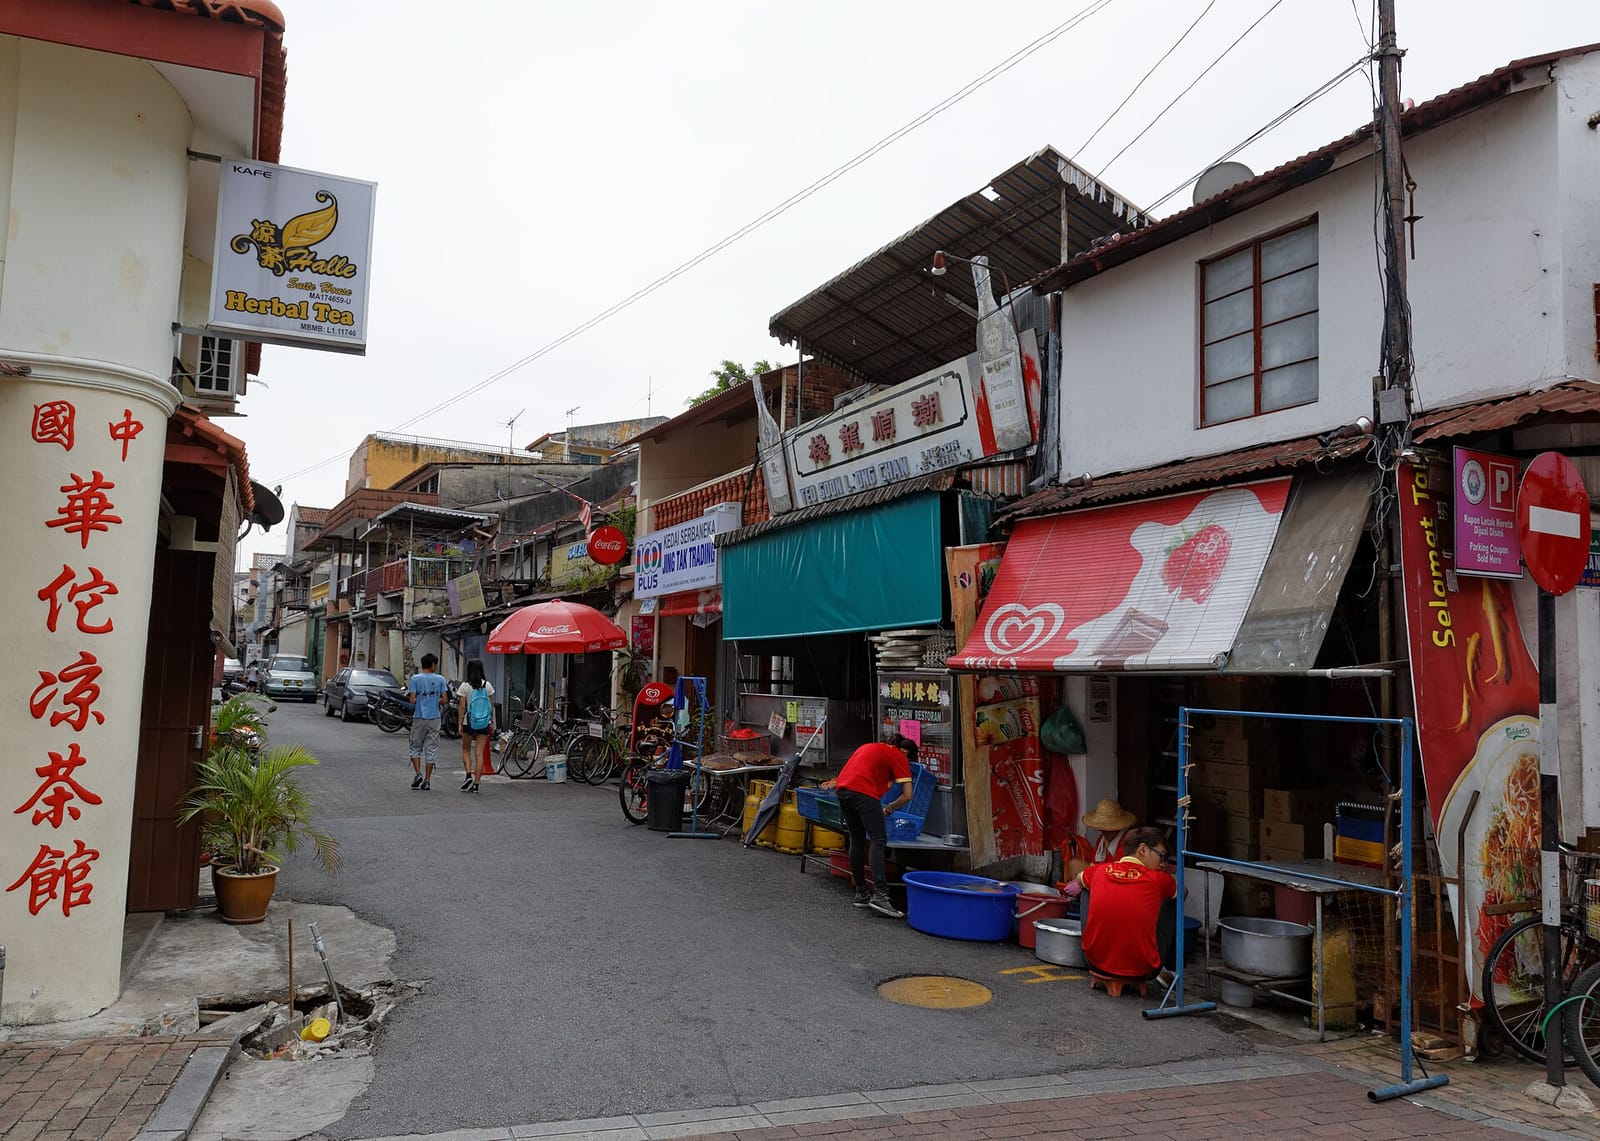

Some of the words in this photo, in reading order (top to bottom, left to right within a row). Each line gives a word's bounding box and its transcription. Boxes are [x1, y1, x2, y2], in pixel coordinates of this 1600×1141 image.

[233, 165, 272, 179] KAFE
[288, 249, 357, 278] Halle
[287, 278, 317, 291] Suite
[320, 282, 353, 296] House
[225, 290, 309, 320] Herbal
[313, 301, 355, 326] Tea
[300, 323, 326, 333] MBMB:
[818, 477, 845, 500] SOON
[877, 456, 911, 484] CHAN
[1495, 469, 1510, 504] P
[663, 533, 680, 549] KEDAI
[680, 519, 716, 545] SERBANEKA
[676, 548, 688, 571] TAK
[688, 541, 716, 569] TRADING
[1469, 541, 1489, 554] Parking
[1489, 544, 1509, 555] Coupon
[1476, 553, 1489, 563] Sold
[638, 574, 658, 592] PLUS
[1419, 516, 1456, 648] Selamat
[888, 708, 898, 719] TEO
[914, 710, 943, 722] RESTORAN
